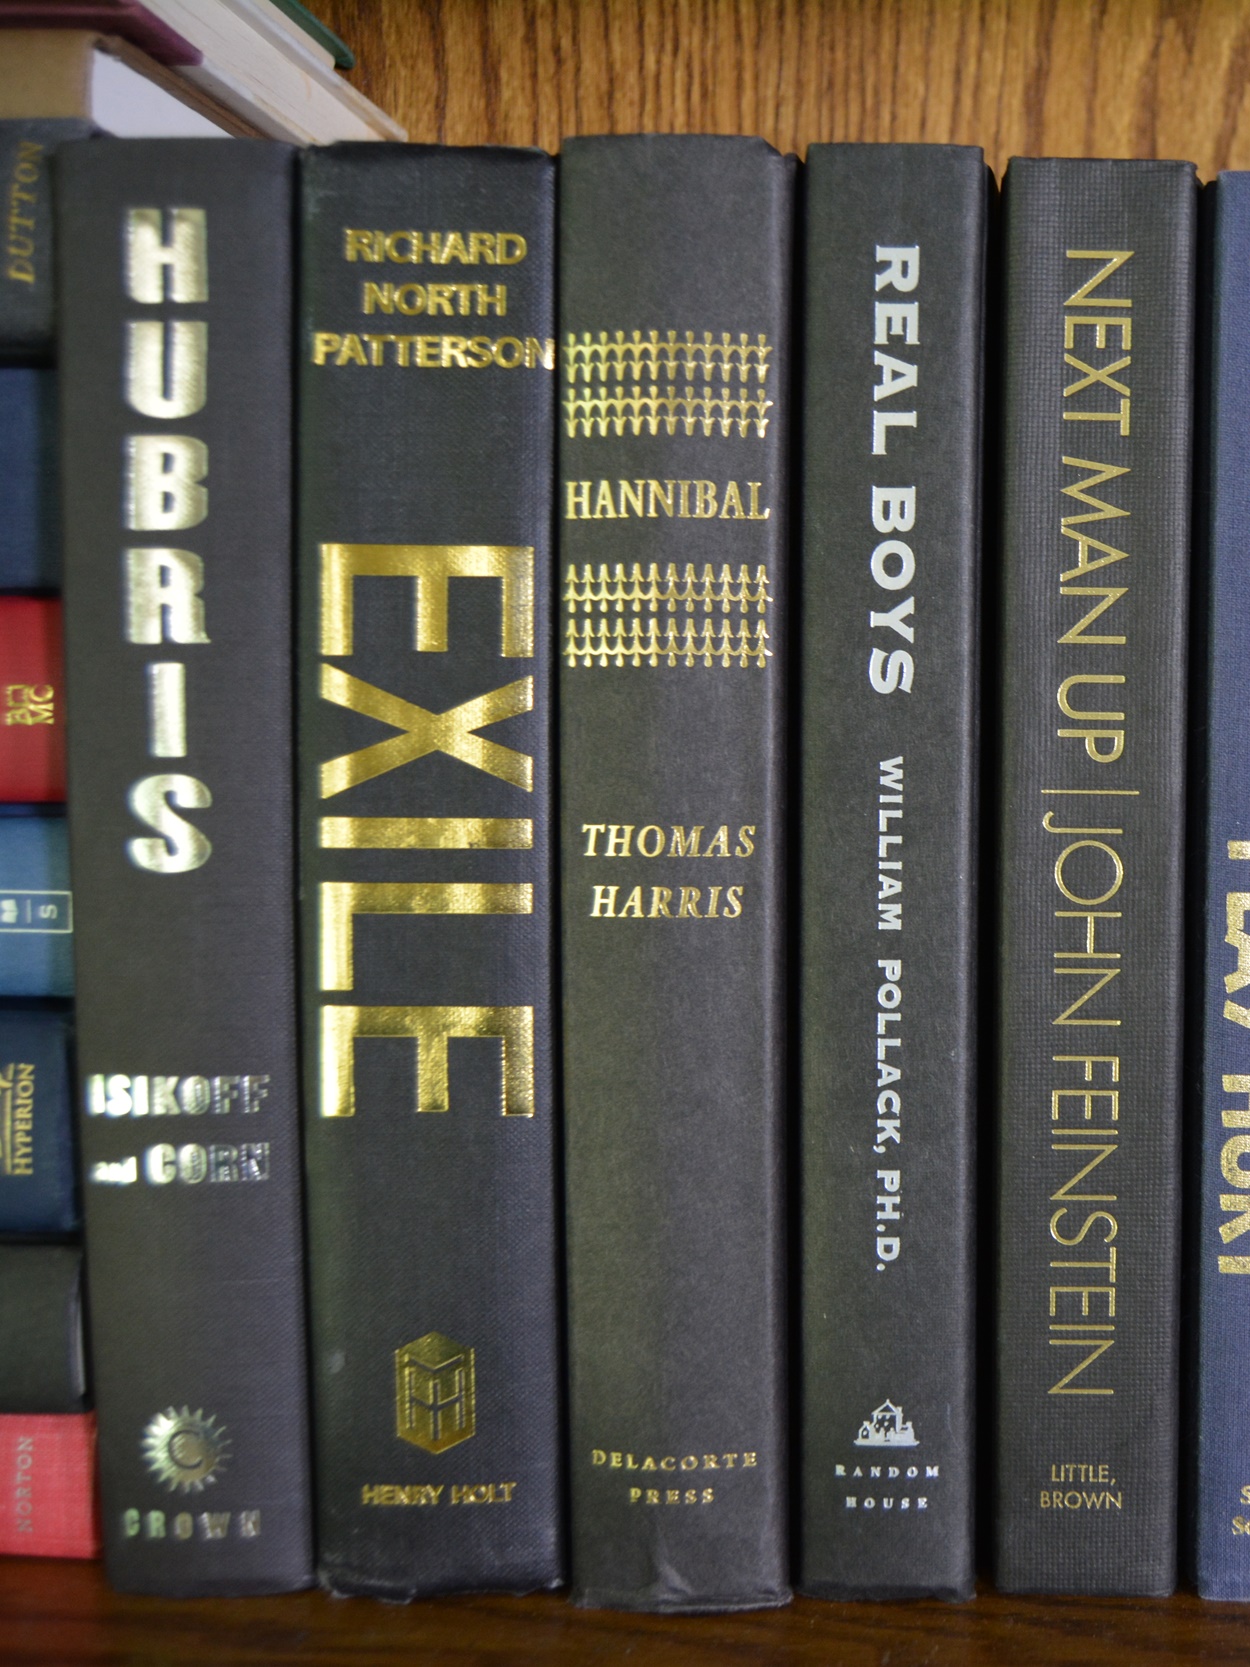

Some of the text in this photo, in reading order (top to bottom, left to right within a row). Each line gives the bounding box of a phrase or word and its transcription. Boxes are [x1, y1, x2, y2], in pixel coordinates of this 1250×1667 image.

[8, 140, 44, 284] DUTTON
[345, 228, 527, 265] RICHARD
[363, 282, 508, 317] NORTH
[312, 332, 555, 370] PATTERSON
[869, 244, 920, 694] REAL BOYS
[565, 479, 771, 520] HANNIBAL
[1056, 249, 1135, 763] NEXT MAN UP
[123, 207, 212, 874] HUBRIS
[320, 544, 535, 1118] EXILE
[582, 824, 756, 858] THOMAS
[589, 885, 744, 918] HARRIS
[873, 756, 903, 1271] WILLIAM POLLACK, PH.D.
[87, 1073, 271, 1117] ISIKOFF
[1042, 810, 1124, 1395] JOHN FEINSTEIN
[13, 1063, 35, 1175] HYPERION
[145, 1142, 270, 1185] CORN
[592, 1449, 757, 1472] DELACORTE
[835, 1464, 940, 1479] RANDOM
[1051, 1464, 1116, 1485] LITTLE,
[15, 1436, 33, 1533] NORTON
[362, 1482, 517, 1505] HENRY HOLT
[630, 1487, 715, 1505] PRESS
[846, 1496, 928, 1510] HOUSE
[1040, 1491, 1122, 1509] BROWN
[123, 1509, 261, 1540] CROWN
